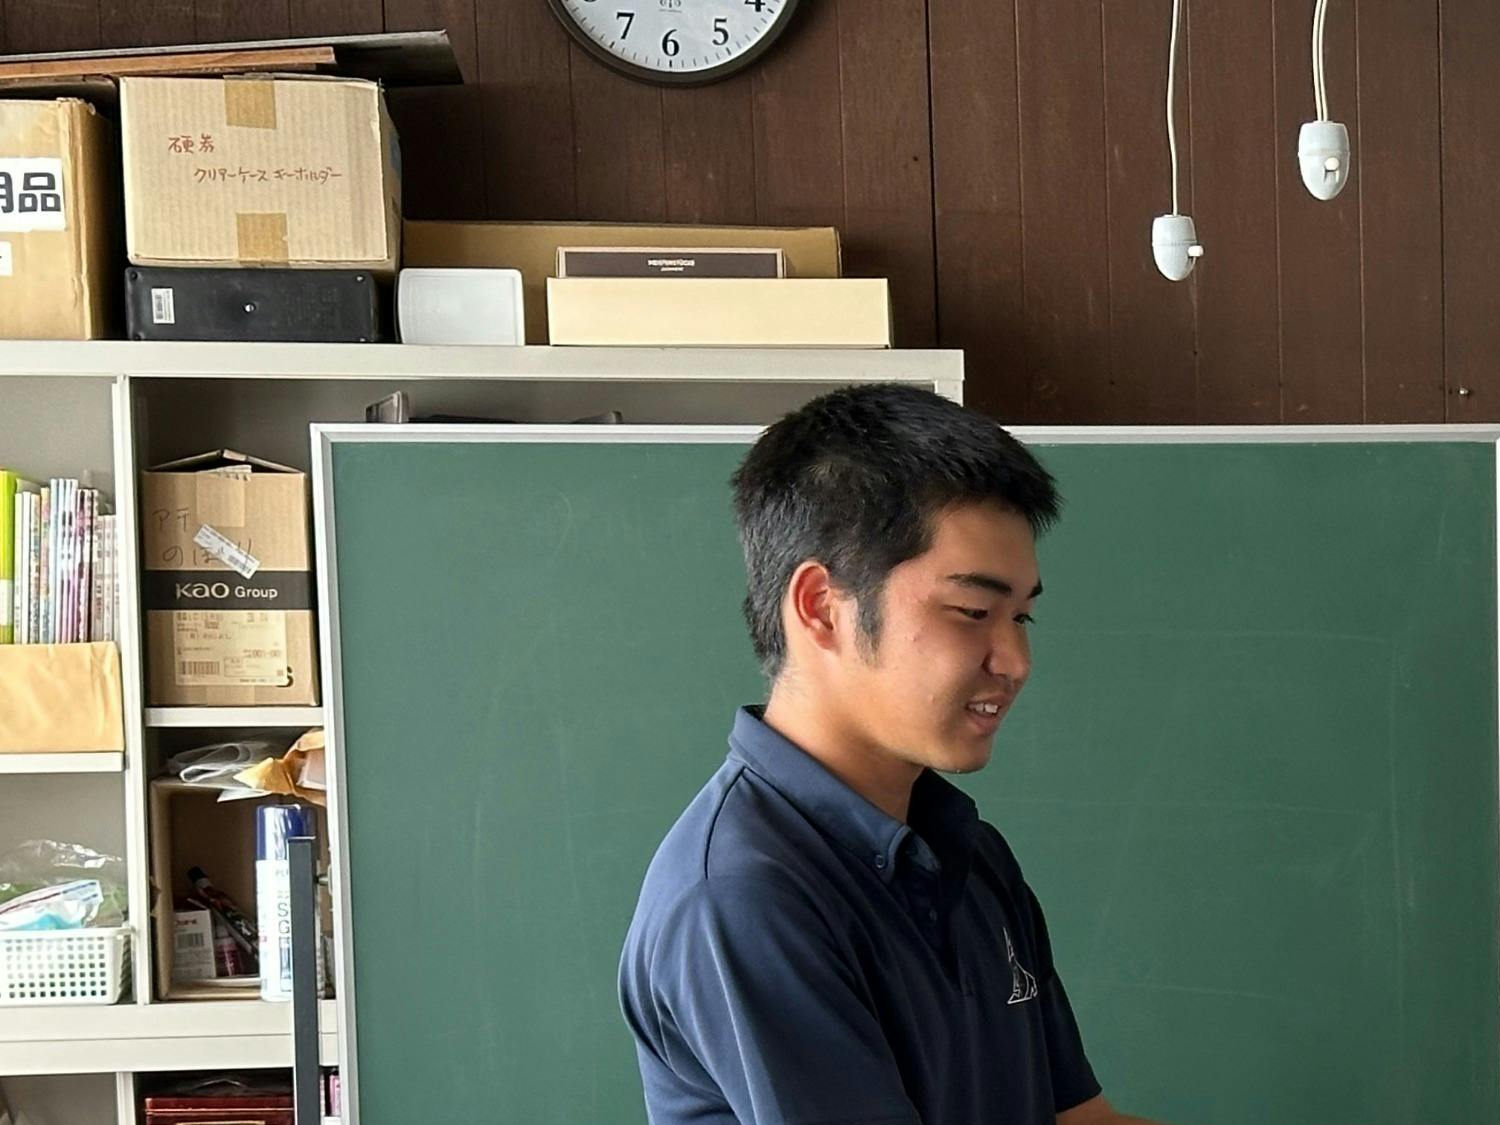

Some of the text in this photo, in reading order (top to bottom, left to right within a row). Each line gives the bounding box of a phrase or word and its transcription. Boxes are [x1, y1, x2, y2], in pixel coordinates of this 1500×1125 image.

[616, 12, 635, 40] 7
[712, 18, 729, 46] 5
[662, 29, 680, 57] 6
[176, 582, 279, 600] Kao Group
